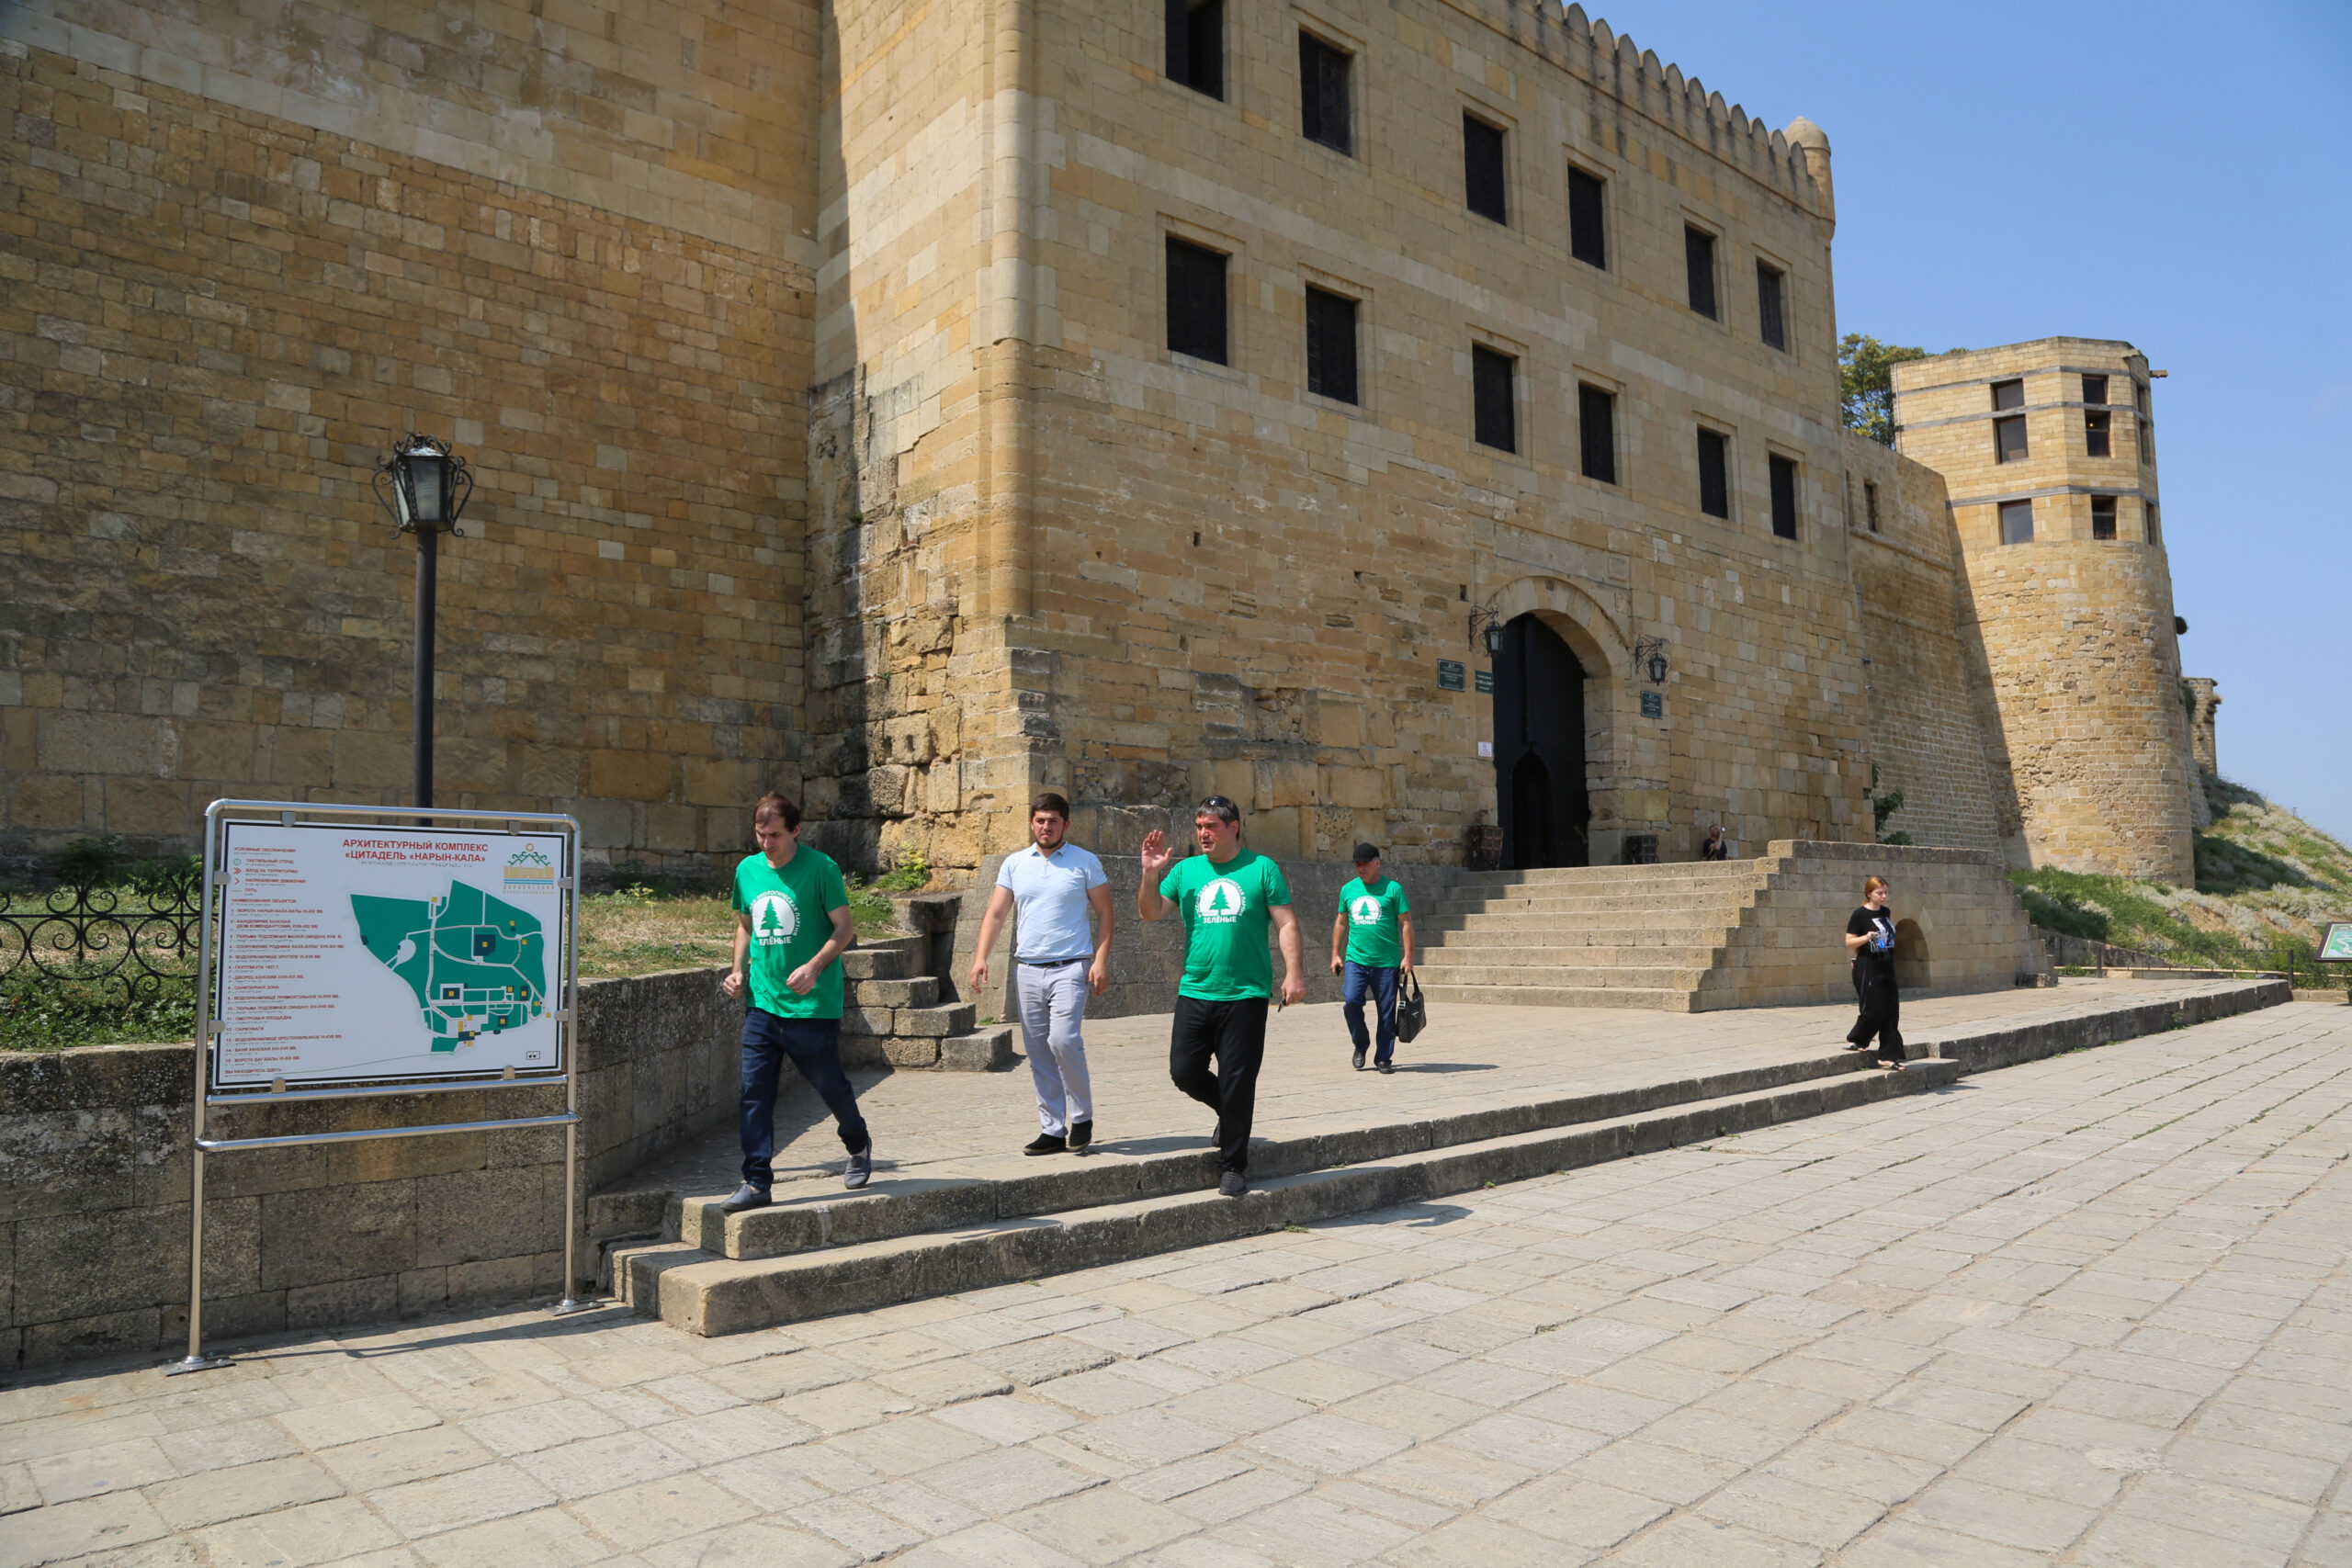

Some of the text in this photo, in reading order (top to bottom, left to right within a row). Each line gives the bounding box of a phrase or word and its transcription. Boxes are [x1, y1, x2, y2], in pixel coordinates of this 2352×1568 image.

[343, 839, 489, 852] АРХИТЕКТУРНЫЙ КОМПЛЕКС
[345, 851, 486, 863] «ЦИТАДЕЛЬ «НАРЫН-КАЛА»
[1203, 915, 1237, 924] ЗЕЛЁНЫЕ
